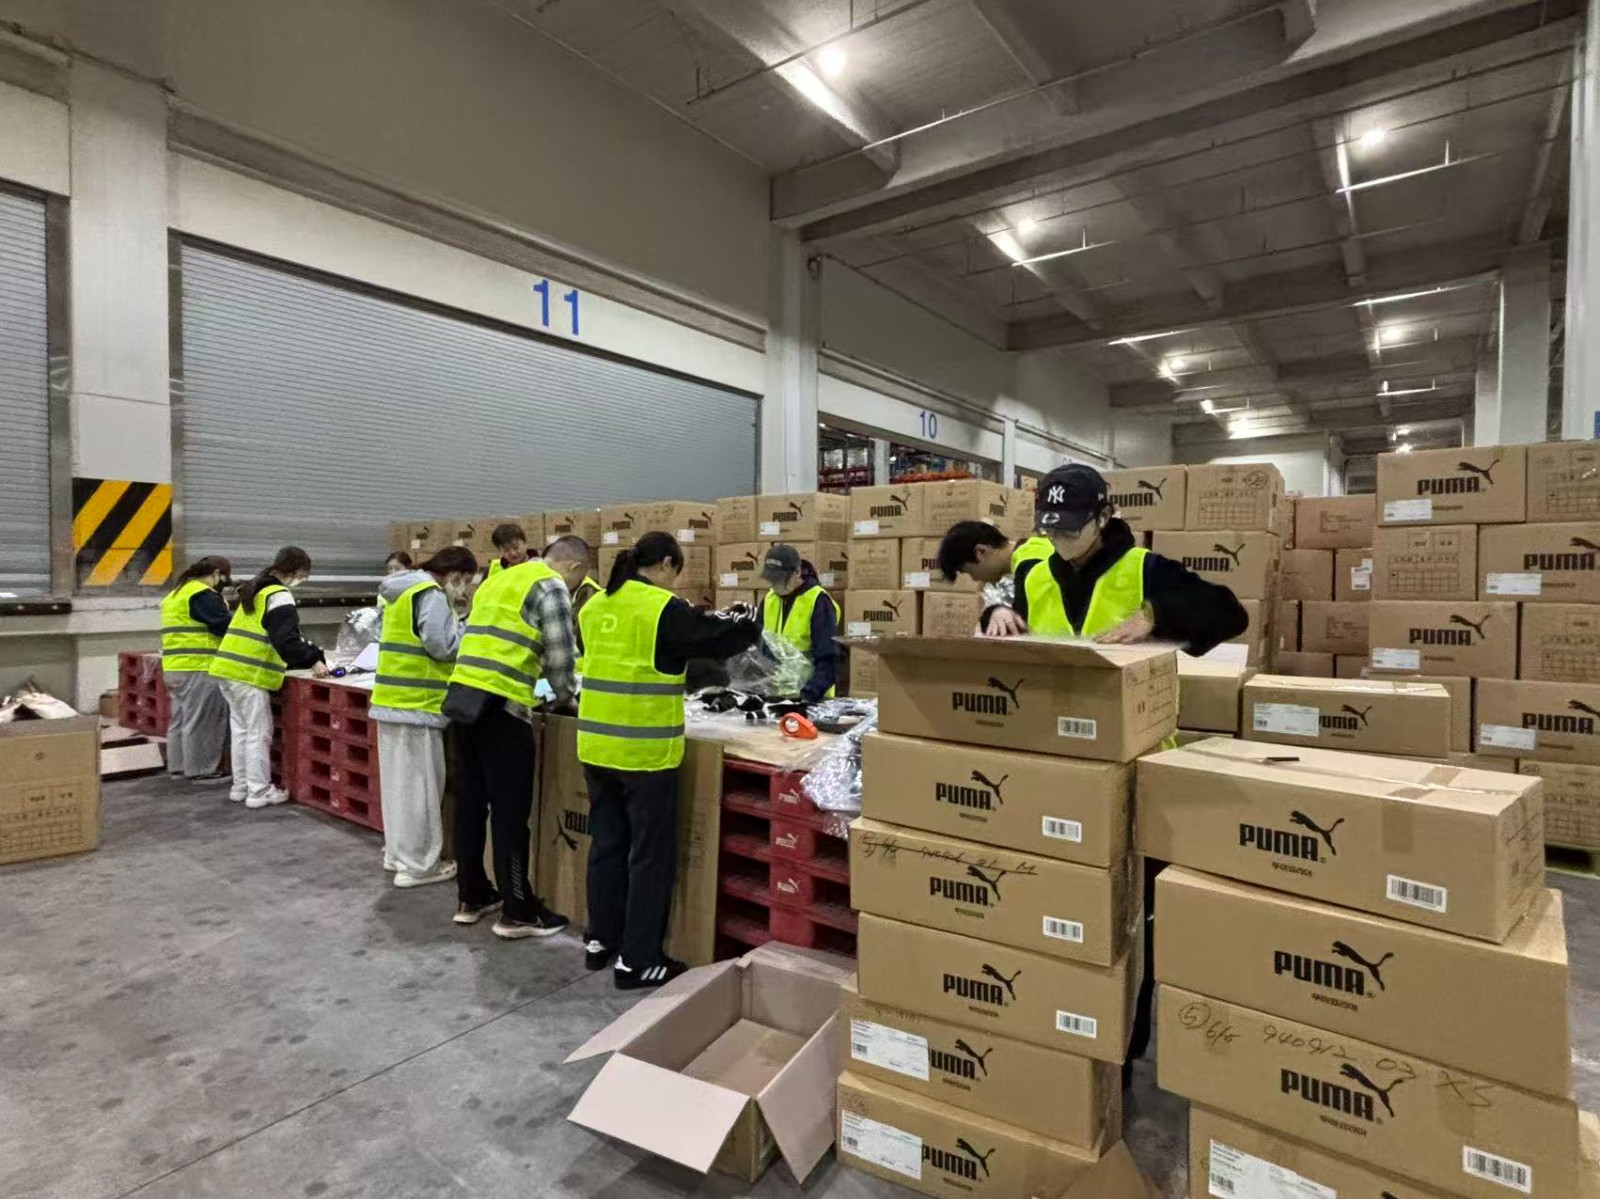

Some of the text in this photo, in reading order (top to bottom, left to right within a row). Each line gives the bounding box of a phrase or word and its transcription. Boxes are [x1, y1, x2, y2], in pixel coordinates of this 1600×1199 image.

[533, 278, 579, 335] 11
[920, 410, 938, 440] 10
[1047, 485, 1066, 504] NY
[1417, 476, 1480, 496] PUMA
[870, 505, 902, 518] PUMA
[1109, 492, 1154, 507] PUMA
[1182, 556, 1231, 572] PUMA
[1523, 553, 1596, 571] PUMA
[863, 610, 894, 622] PUMA
[1409, 627, 1472, 647] PUMA
[952, 692, 1008, 716] PUMA
[1521, 712, 1594, 736] PUMA
[935, 782, 992, 811] PUMA
[1239, 823, 1319, 862] PUMA
[929, 876, 989, 907] PUMA
[1274, 950, 1365, 996] PUMA
[943, 973, 1003, 1006] PUMA
[928, 1047, 976, 1081] UMA
[1280, 1068, 1375, 1122] PUMA
